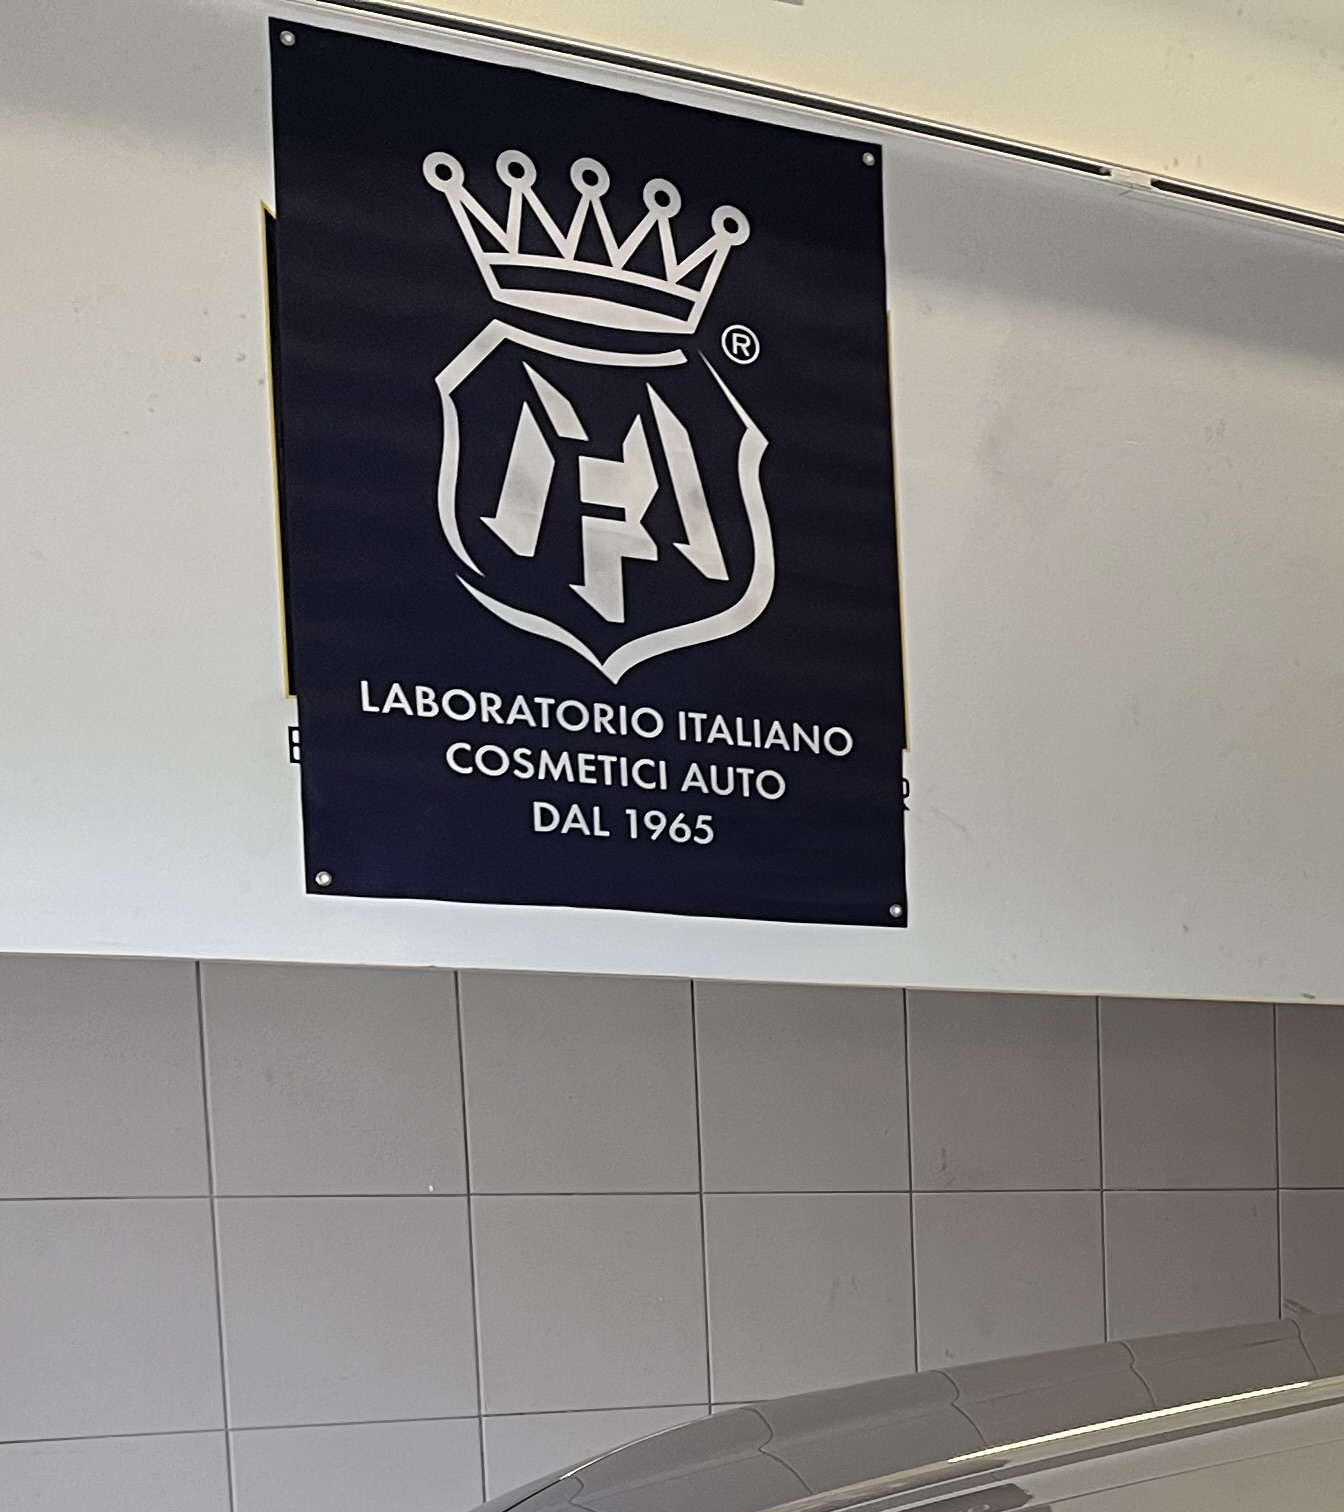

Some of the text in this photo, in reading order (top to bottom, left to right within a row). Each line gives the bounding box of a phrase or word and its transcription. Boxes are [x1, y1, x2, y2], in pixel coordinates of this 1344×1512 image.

[360, 680, 854, 757] LABORATORIO ITALIANO
[445, 742, 786, 800] COSMETICI AUTO
[533, 801, 714, 845] DAL 1965
